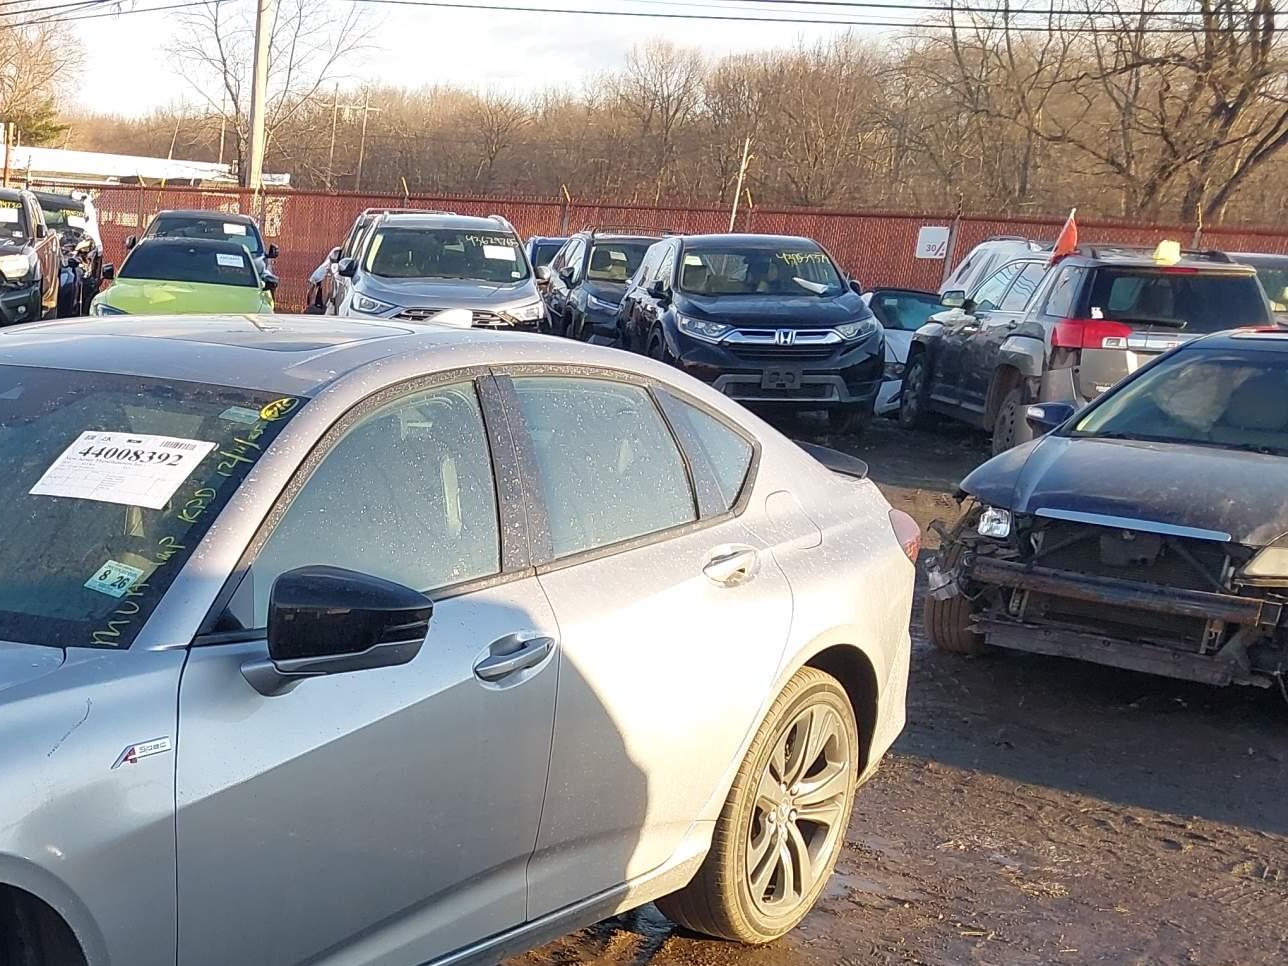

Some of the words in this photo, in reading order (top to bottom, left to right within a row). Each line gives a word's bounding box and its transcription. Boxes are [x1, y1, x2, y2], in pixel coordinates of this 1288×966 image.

[925, 244, 937, 252] 30
[77, 445, 184, 467] 44008392
[98, 569, 111, 581] 8
[110, 576, 130, 590] 26
